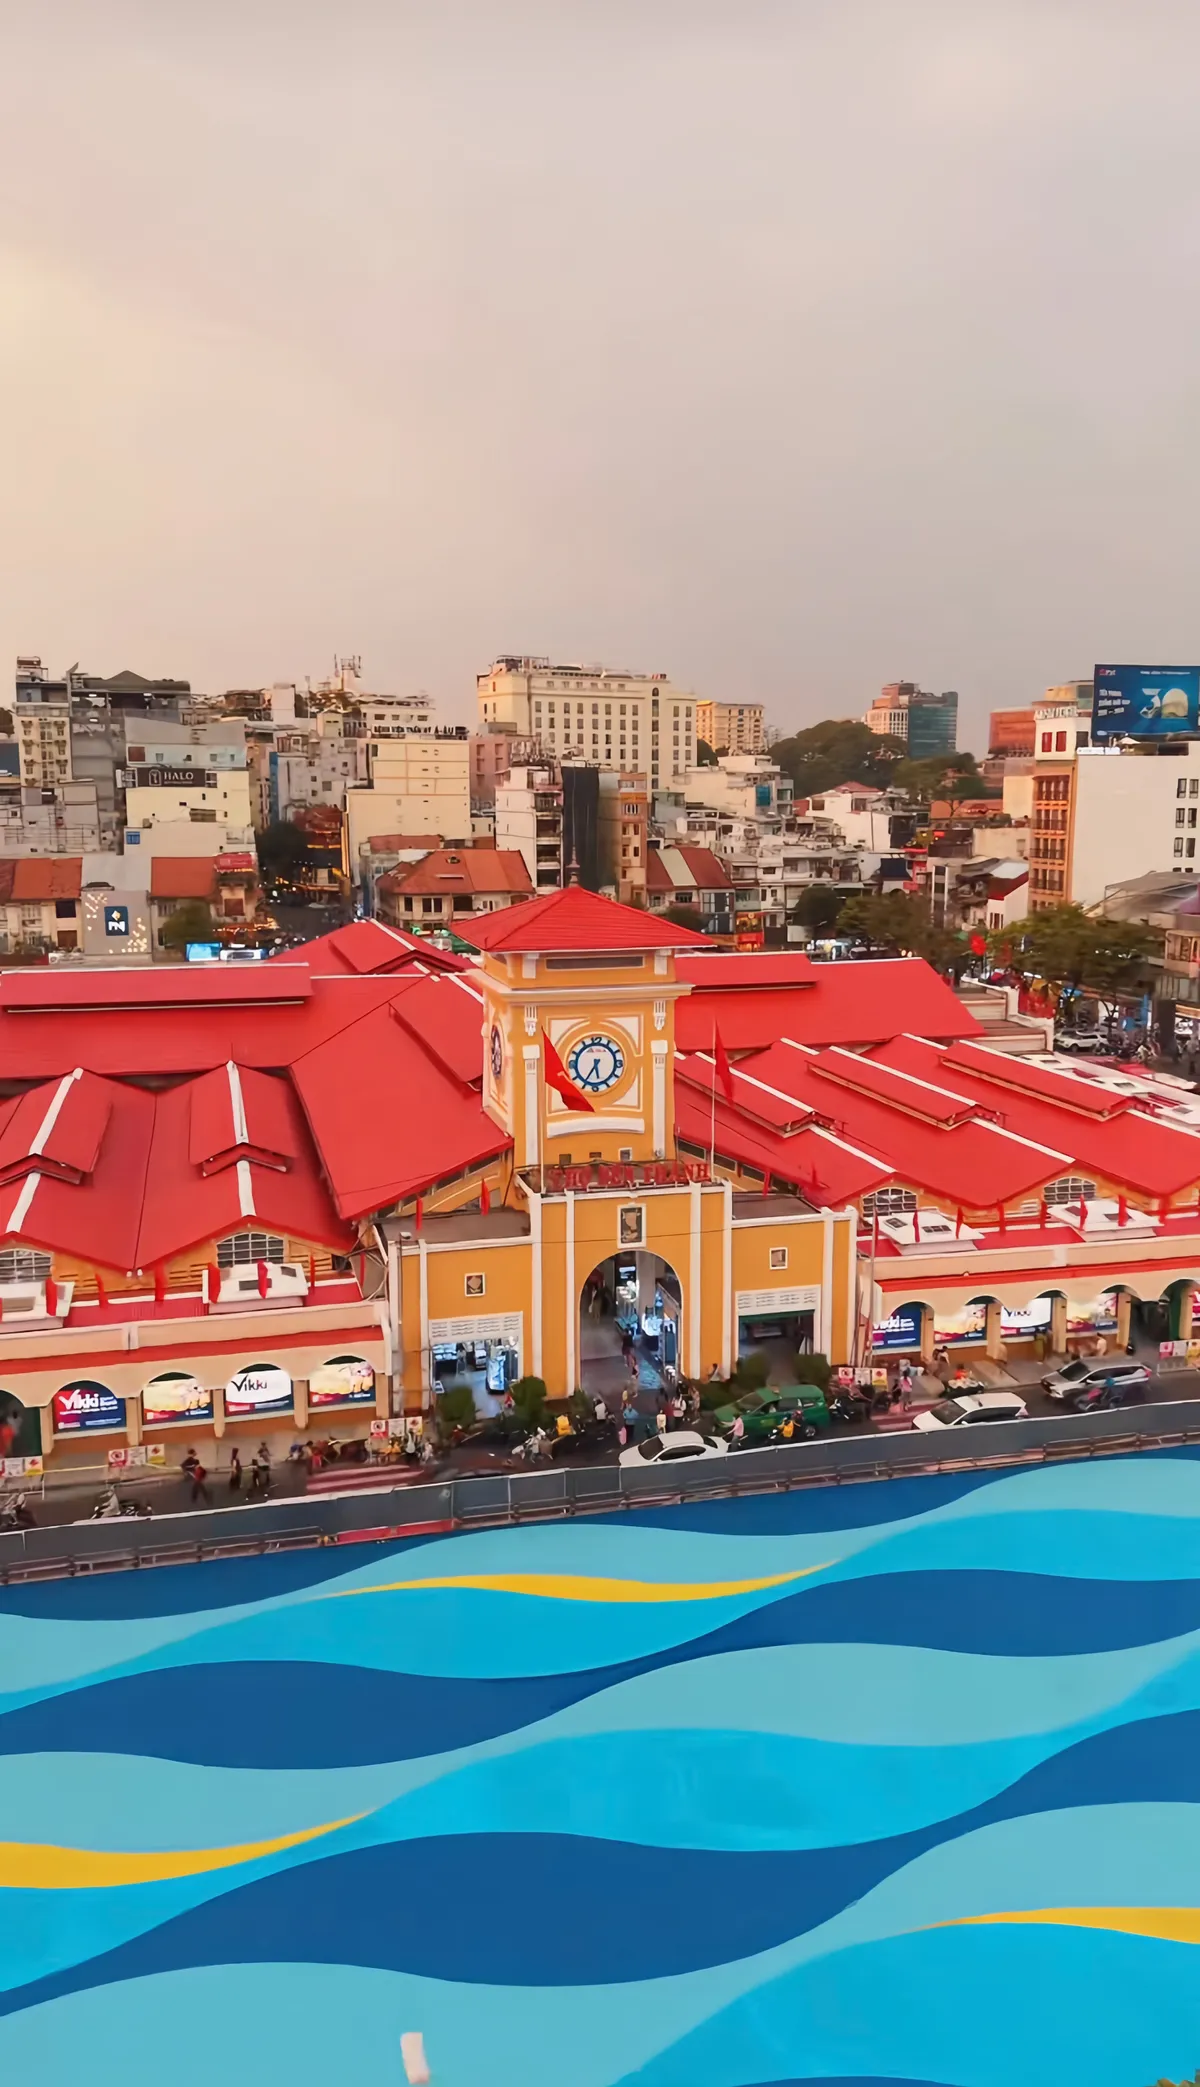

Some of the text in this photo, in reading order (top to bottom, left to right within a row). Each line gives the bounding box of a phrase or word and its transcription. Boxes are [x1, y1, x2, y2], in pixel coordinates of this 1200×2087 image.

[164, 771, 194, 781] HALO
[231, 1373, 267, 1393] Vikki
[58, 1388, 99, 1411] Vikki
